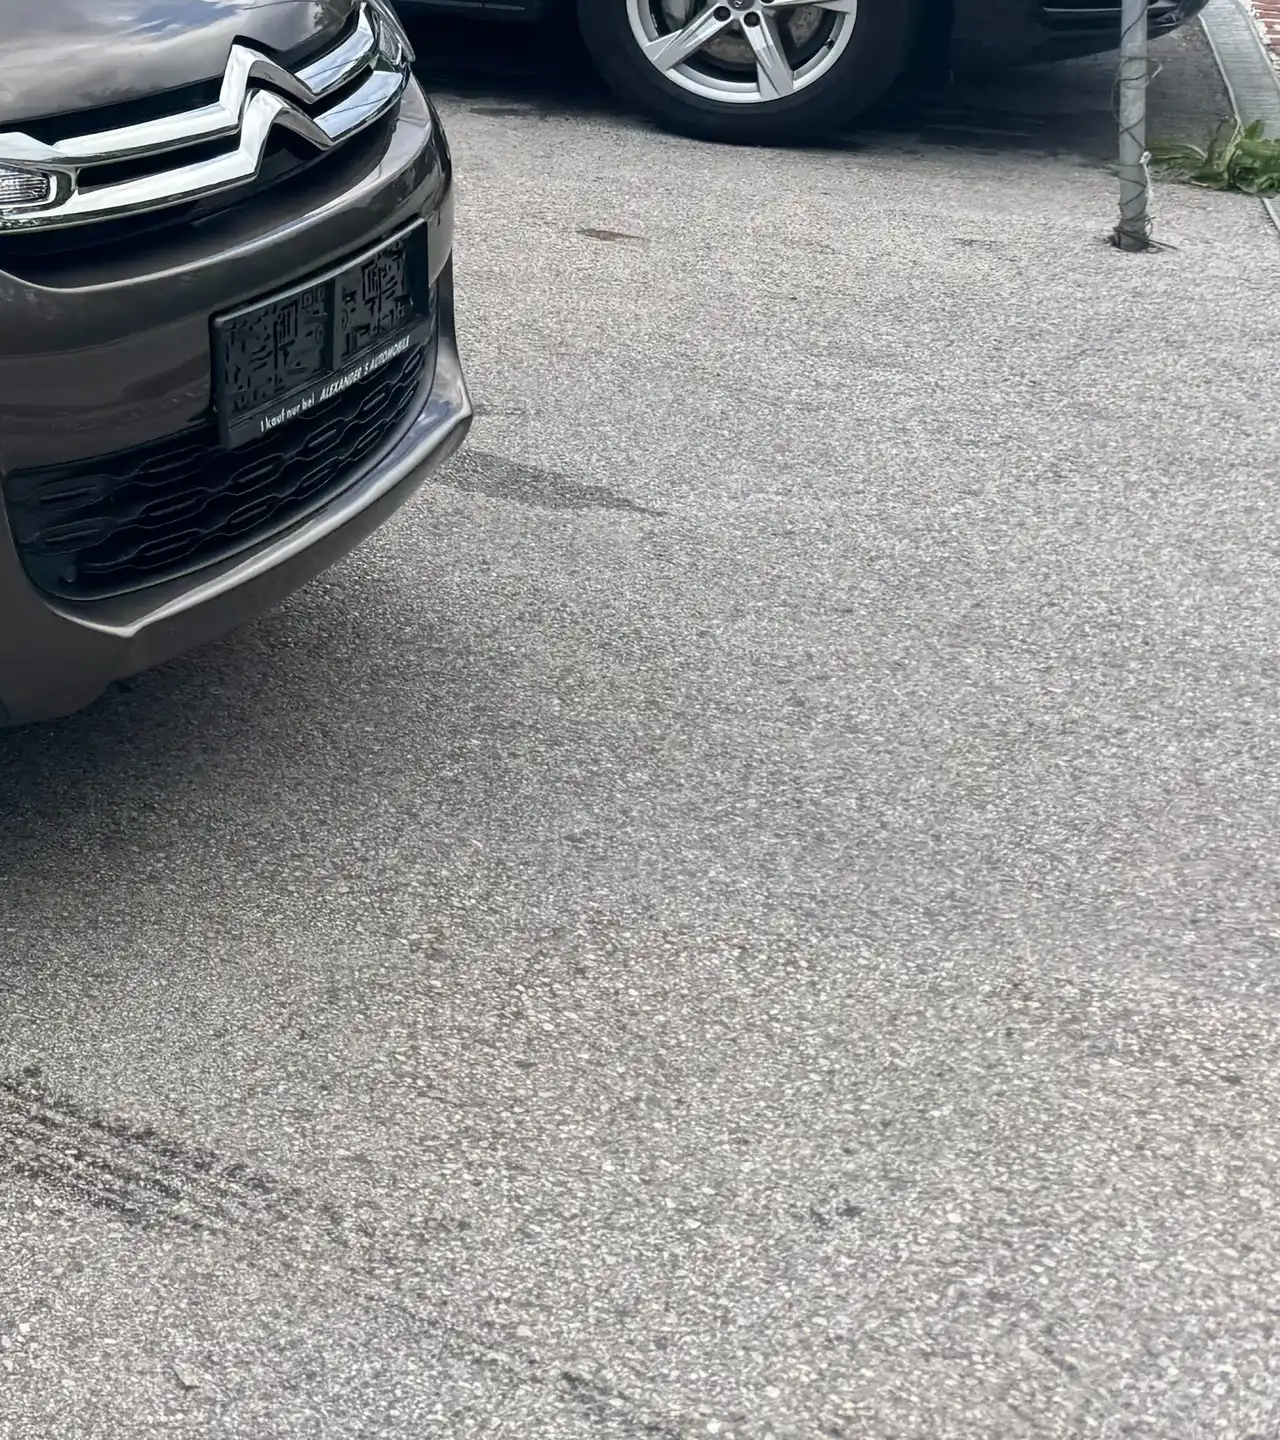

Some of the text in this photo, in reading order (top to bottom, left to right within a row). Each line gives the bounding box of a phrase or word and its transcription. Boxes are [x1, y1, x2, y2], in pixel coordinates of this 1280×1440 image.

[265, 408, 285, 429] kauf
[286, 404, 301, 420] nur
[302, 392, 315, 410] bei
